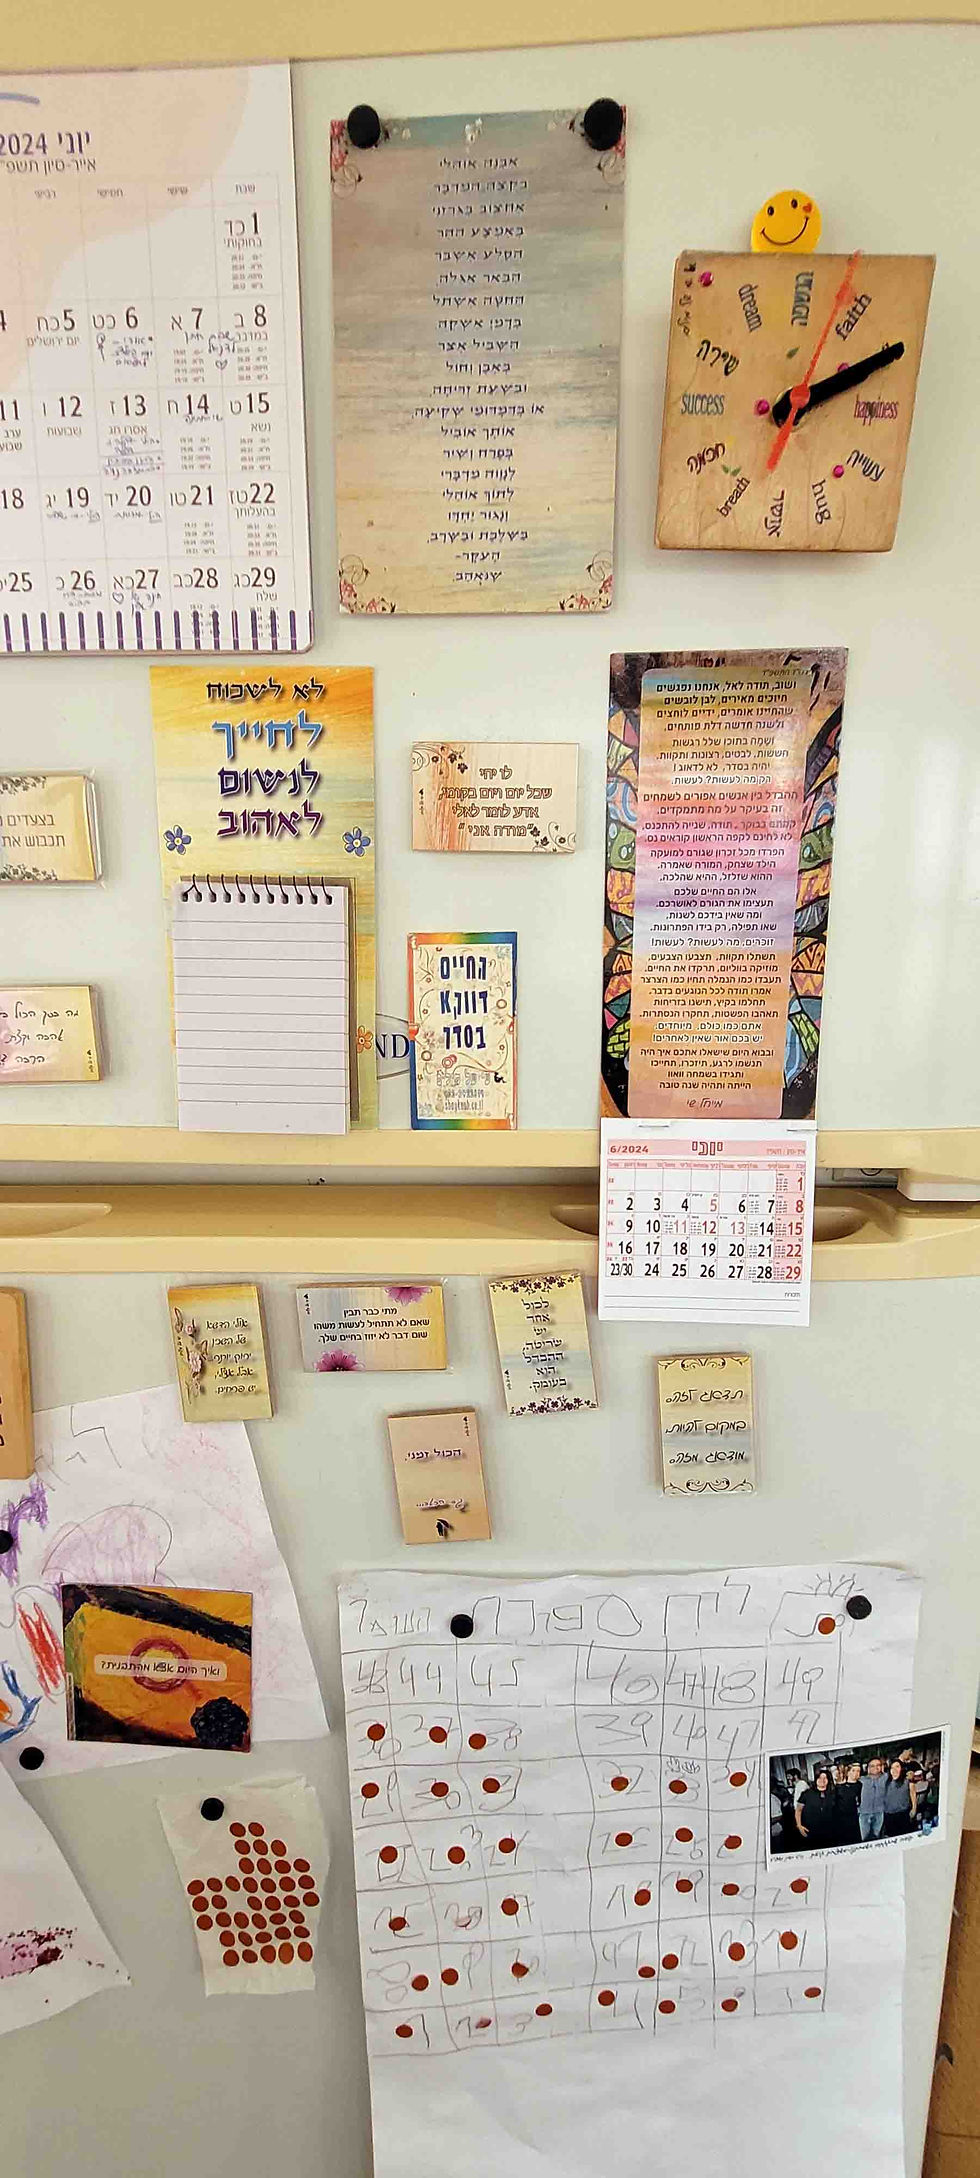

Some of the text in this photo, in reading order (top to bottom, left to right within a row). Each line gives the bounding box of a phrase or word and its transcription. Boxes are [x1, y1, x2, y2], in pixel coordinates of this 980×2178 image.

[58, 132, 90, 154] יוני
[236, 184, 255, 193] שבת
[252, 212, 259, 235] 1
[738, 283, 762, 332] dream
[64, 310, 75, 330] 5
[126, 307, 138, 328] 6
[192, 308, 202, 330] 7
[255, 305, 266, 327] 8
[835, 293, 872, 340] faith
[26, 335, 79, 346] יום ירושלים
[696, 339, 740, 376] שירה
[60, 396, 82, 417] 12
[124, 395, 146, 416] 13
[187, 394, 209, 414] 14
[248, 392, 269, 413] 15
[680, 392, 724, 416] success
[854, 395, 898, 426] happiness
[4, 429, 21, 438] ערב
[47, 427, 81, 436] שבועות
[251, 423, 270, 432] נשא
[67, 487, 88, 508] 19
[126, 486, 151, 506] 20
[191, 486, 212, 505] 21
[250, 483, 274, 504] 22
[716, 476, 750, 518] breath
[812, 479, 831, 526] hug
[234, 504, 275, 518] בהעלותך
[9, 572, 32, 592] 25
[71, 571, 95, 590] 26
[133, 570, 158, 589] 27
[191, 568, 218, 588] 28
[249, 568, 275, 587] 29
[256, 590, 277, 602] שלח
[206, 677, 325, 702] לא לשכוח
[657, 684, 691, 692] נפגשים
[693, 683, 719, 691] אנחנו
[747, 682, 769, 690] תודה
[664, 695, 700, 706] לובשים
[701, 694, 716, 706] לבן
[758, 695, 787, 703] חיוכים
[212, 710, 322, 758] לחייך
[218, 758, 320, 797] לנשום
[479, 765, 512, 780] לו יהי
[479, 788, 502, 799] ויום
[505, 788, 524, 799] יום
[526, 785, 552, 799] שכל
[452, 804, 539, 818] אדע לומר לאלי
[7, 815, 55, 826] בצעדים
[217, 800, 323, 838] לאהוב
[2, 836, 65, 847] תכבוש את
[674, 887, 698, 898] שלכם
[728, 888, 740, 897] הם
[441, 956, 486, 980] החיים
[708, 976, 735, 985] הנמלה
[738, 977, 754, 985] כמו
[755, 976, 781, 984] תעבדו
[440, 990, 488, 1020] דווקא
[443, 1025, 486, 1049] בסדר
[658, 1049, 670, 1057] איך
[673, 1049, 697, 1058] אתכם
[700, 1048, 730, 1056] שישאלו
[702, 1080, 725, 1089] ותהיה
[727, 1080, 751, 1089] הייתה
[692, 1141, 723, 1156] יוני
[626, 1198, 633, 1210] 2
[729, 1244, 744, 1256] 20
[784, 1244, 802, 1258] 22
[728, 1266, 743, 1278] 27
[784, 1266, 800, 1280] 29
[522, 1297, 549, 1311] לכול
[344, 1310, 361, 1318] תבין
[526, 1314, 550, 1324] אחד
[337, 1319, 364, 1329] לעשות
[367, 1320, 394, 1328] תתחיל
[396, 1318, 407, 1326] לא
[534, 1327, 546, 1338] יש
[536, 1365, 558, 1376] הוא
